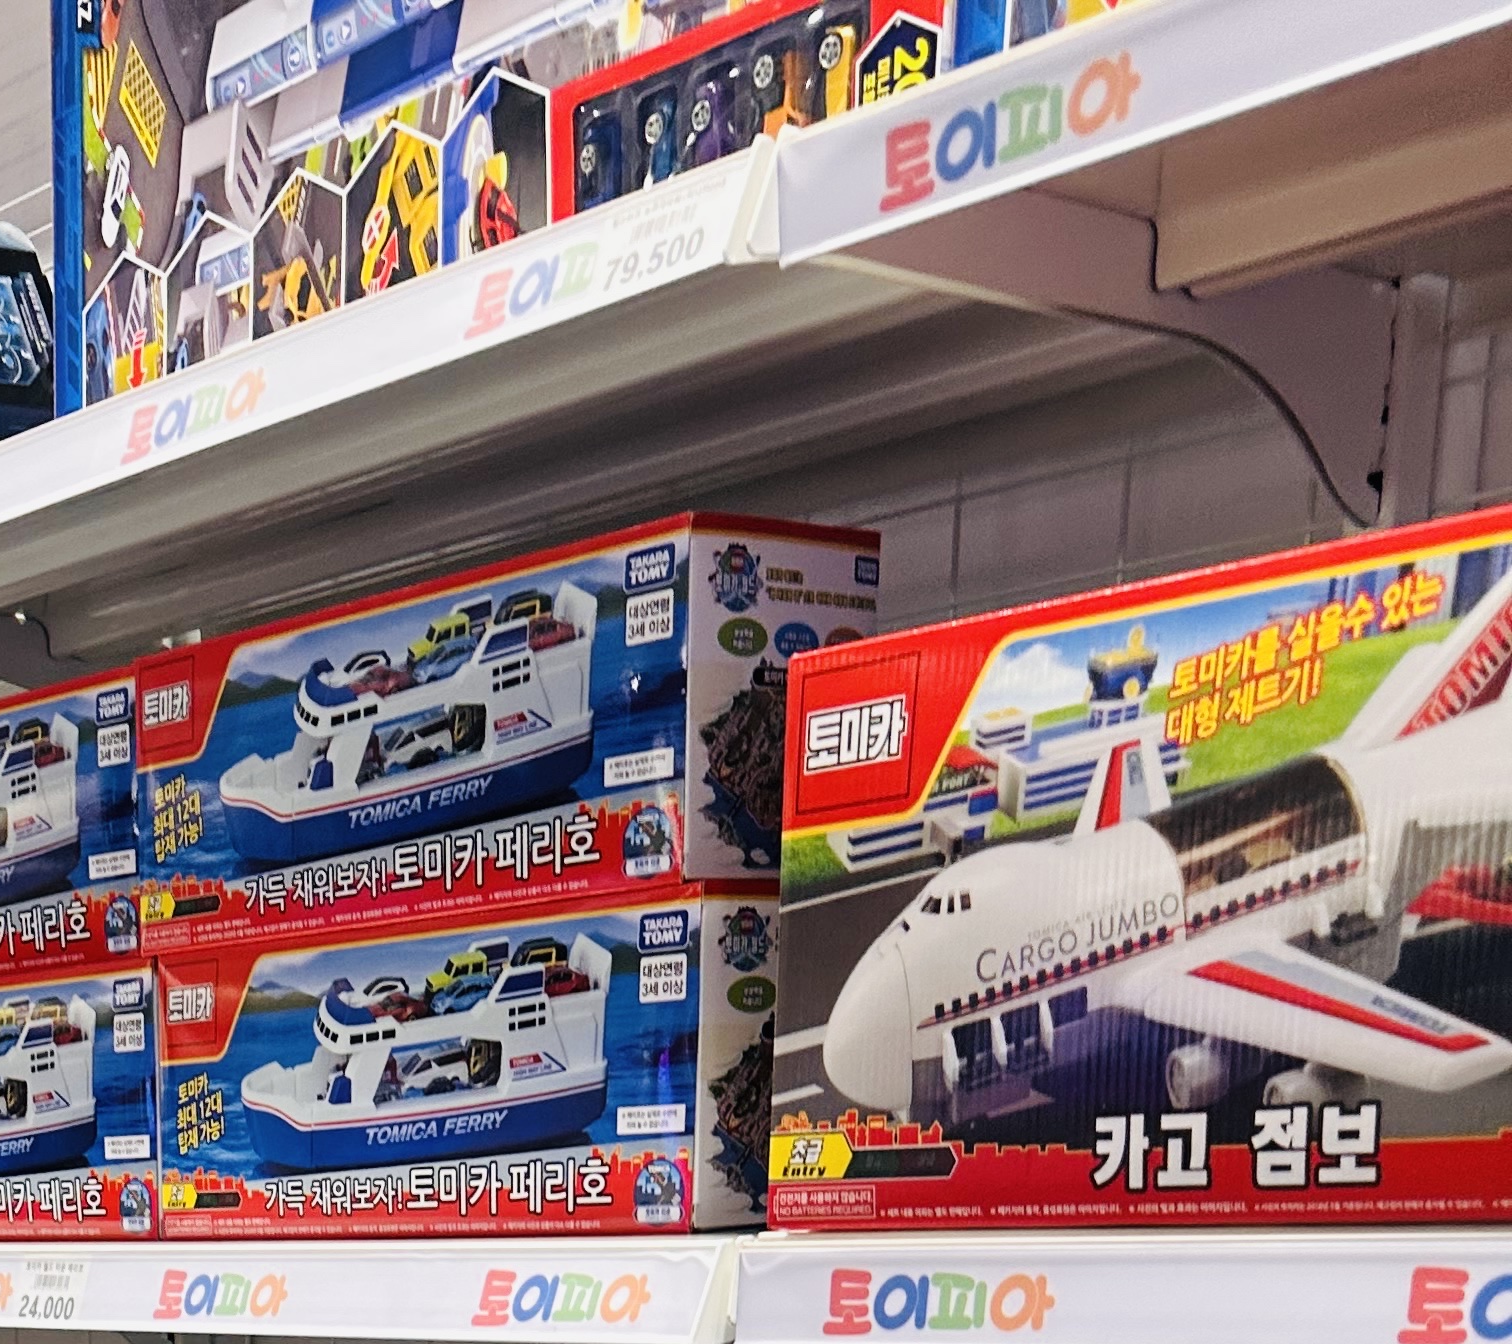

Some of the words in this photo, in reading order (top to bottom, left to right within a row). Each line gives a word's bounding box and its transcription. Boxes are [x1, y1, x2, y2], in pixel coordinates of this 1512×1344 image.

[879, 50, 1142, 213] 토이피아
[120, 367, 266, 466] 토이피아
[628, 550, 671, 572] TAKARA
[629, 564, 671, 587] TOMY
[628, 621, 649, 638] 3세
[650, 616, 671, 637] 이상
[1169, 625, 1281, 700] 토미카를
[1288, 592, 1377, 662] 실을수
[1381, 571, 1445, 632] 있는
[142, 684, 190, 726] 토미카
[1165, 692, 1220, 746] 대형
[1224, 658, 1322, 727] 제트기!
[806, 694, 904, 773] 토미카
[348, 797, 421, 830] TOMICA
[428, 774, 494, 813] FERRY
[245, 875, 288, 916] 가득
[291, 858, 387, 906] 채워보자!
[391, 837, 488, 896] 토미카
[496, 814, 602, 880] 페리호
[20, 902, 91, 953] 페리호
[642, 914, 683, 932] TAKARA
[643, 928, 683, 946] TOMY
[975, 927, 1080, 985] CARGO
[1085, 891, 1181, 949] JUMBO
[642, 961, 684, 980] 대상연령
[642, 982, 664, 999] 3세
[664, 980, 685, 998] 이상
[167, 986, 214, 1025] 토미카
[178, 1072, 208, 1103] 토미카
[365, 1118, 439, 1146] TOMICA
[444, 1110, 508, 1137] FERRY
[1092, 1110, 1210, 1189] 카고
[1251, 1101, 1380, 1189] 점보
[264, 1181, 307, 1217] 가득
[311, 1175, 403, 1216] 채워보자!
[405, 1165, 502, 1216] 토미카
[509, 1158, 613, 1215] 페리호
[782, 1165, 827, 1178] Entry
[40, 1177, 107, 1222] 페리호
[18, 1294, 75, 1320] 24,000
[152, 1268, 289, 1320] 토이피아
[471, 1269, 653, 1329] 토이피아
[822, 1266, 1056, 1336] 토이피아
